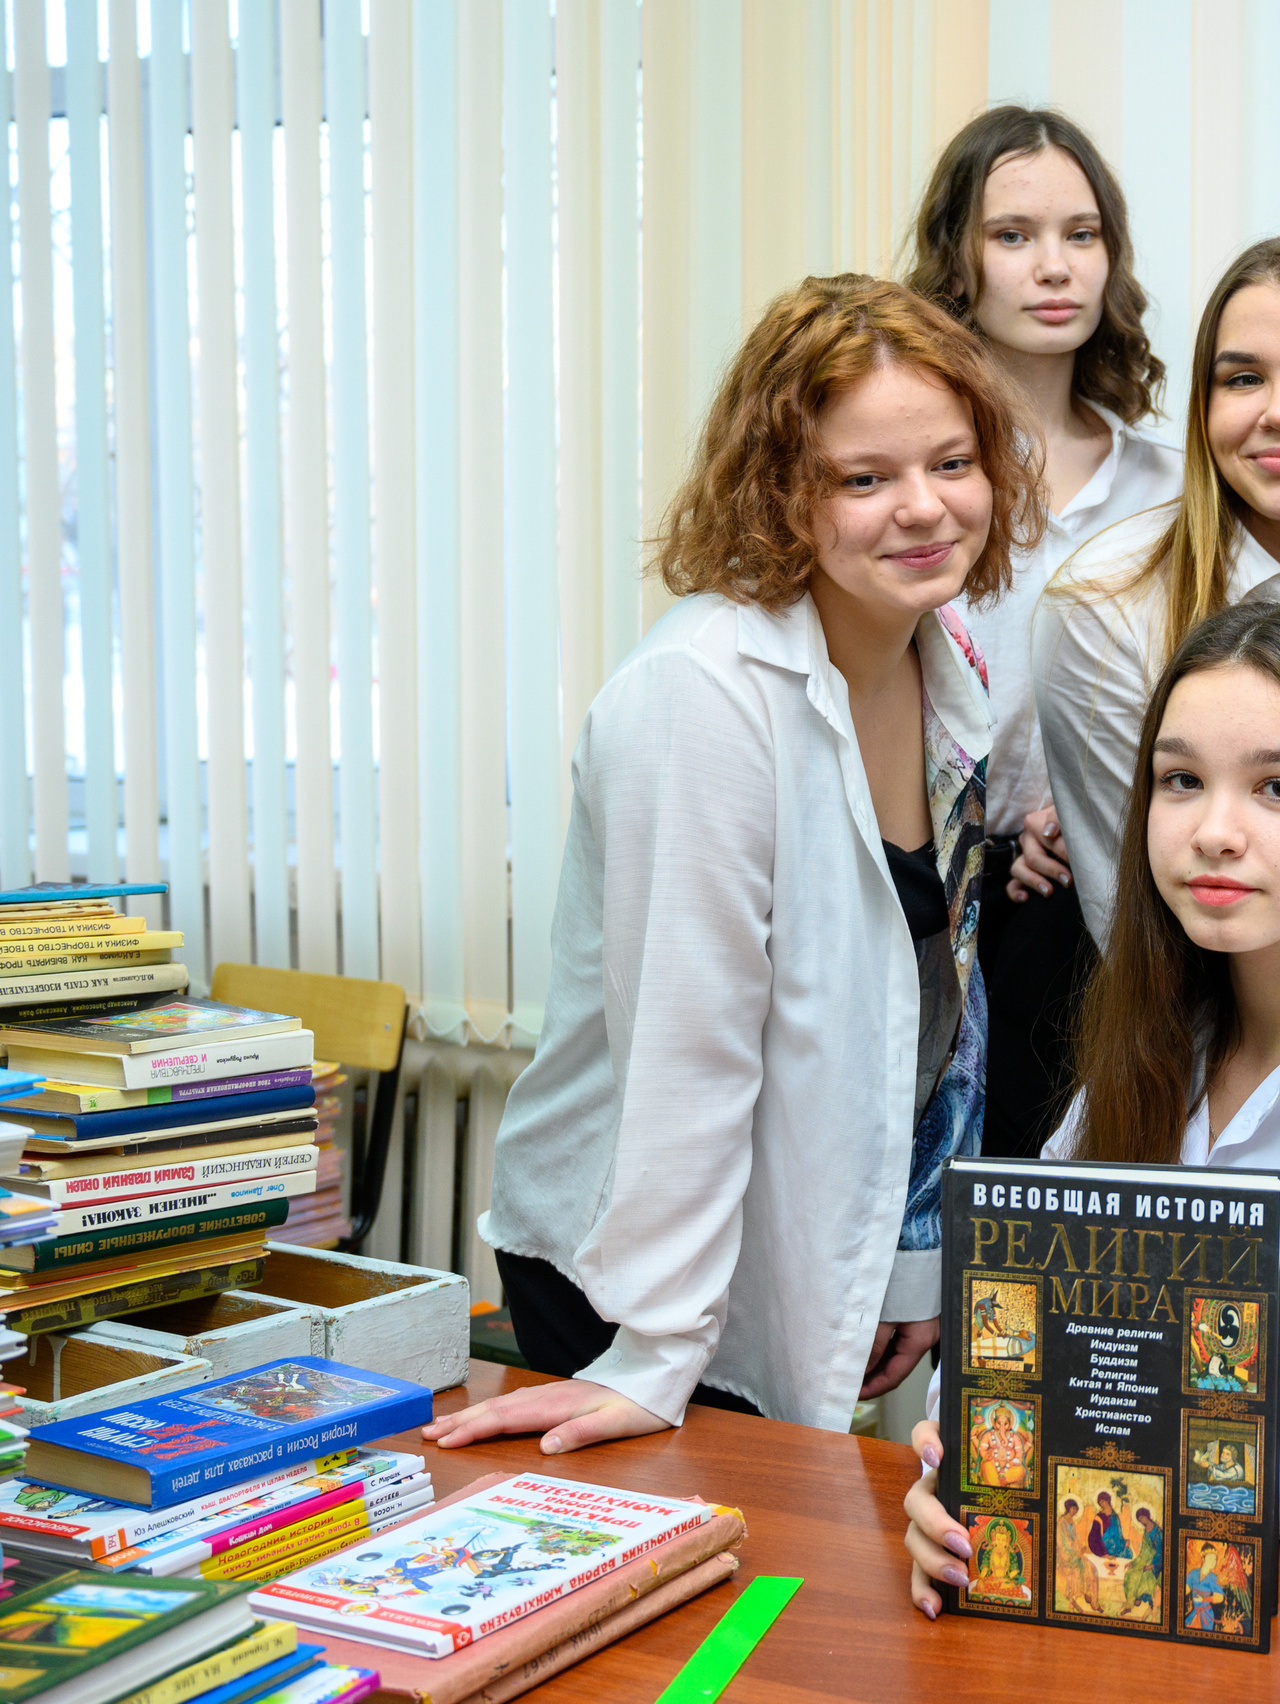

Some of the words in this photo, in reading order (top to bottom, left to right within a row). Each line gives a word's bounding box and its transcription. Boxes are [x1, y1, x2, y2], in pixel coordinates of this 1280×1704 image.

[9, 925, 66, 936] ТВОРЧЕСТВО
[76, 923, 111, 931] ФИЗИКА
[37, 941, 95, 951] ТВОРЧЕСТВО
[105, 939, 140, 948] ФИЗИКА
[26, 956, 68, 968] ВЫБИРАТЬ
[71, 954, 88, 964] КАК
[63, 980, 89, 990] СТАТЬ
[91, 978, 109, 987] КАК
[151, 1054, 199, 1069] СВЕРШЕНИЯ
[201, 1053, 208, 1062] И
[150, 1063, 206, 1079] ПРЕДЧУВСТВИЯ
[202, 1159, 271, 1178] МЕДЫНСКИЙ
[274, 1153, 312, 1169] СЕРГЕЙ
[231, 1185, 263, 1198] Данилов
[266, 1183, 285, 1192] Олег
[973, 1183, 1121, 1216] ВСЕОБЩАЯ
[1136, 1195, 1265, 1227] ИСТОРИЯ
[82, 1206, 142, 1227] ЗАКОНА!
[199, 1211, 266, 1232] СОВЕТСКИЕ
[98, 1223, 195, 1251] ВООРУЖЕННЫЕ
[54, 1240, 94, 1259] СИЛЫ
[969, 1217, 1263, 1287] РЕЛИГИЙ
[1048, 1276, 1180, 1323] МИРА
[1066, 1322, 1115, 1338] Древние
[1117, 1327, 1163, 1341] религии
[1090, 1338, 1139, 1354] Индуизм
[1090, 1354, 1138, 1369] Буддизм
[1090, 1368, 1137, 1382] Религии
[1069, 1377, 1102, 1390] Китая
[1105, 1382, 1113, 1391] и
[1116, 1381, 1159, 1395] Японии
[1090, 1393, 1137, 1408] Иудаизм
[1075, 1406, 1152, 1424] Христианство
[321, 1421, 358, 1444] История
[1095, 1422, 1131, 1437] Ислам
[276, 1448, 283, 1456] в
[287, 1434, 319, 1454] России
[227, 1446, 273, 1468] рассказах
[204, 1461, 225, 1480] для
[378, 1471, 401, 1484] Маршак
[172, 1471, 200, 1492] детей
[133, 1527, 146, 1537] Юз
[147, 1509, 195, 1532] Алешковский
[266, 1474, 286, 1487] ЦЕЛАЯ
[286, 1465, 308, 1479] НЕДЕЛЯ
[375, 1491, 399, 1504] СУТЕЕВ
[544, 1496, 616, 1513] БАРОНА
[373, 1504, 395, 1517] НОСОВ
[487, 1495, 643, 1529] ПРИКЛЮЧЕНИЯ
[327, 1521, 352, 1535] траве
[353, 1517, 360, 1526] В
[218, 1534, 286, 1566] Новогодние
[289, 1515, 334, 1538] истории
[228, 1529, 257, 1546] Кошкин
[258, 1523, 273, 1535] Дом
[297, 1529, 325, 1547] сидел
[622, 1514, 702, 1563] ПРИКЛЮЧЕНИЯ
[569, 1557, 616, 1589] БАРОНА
[270, 1586, 340, 1606] БИБЛИОТЕКА
